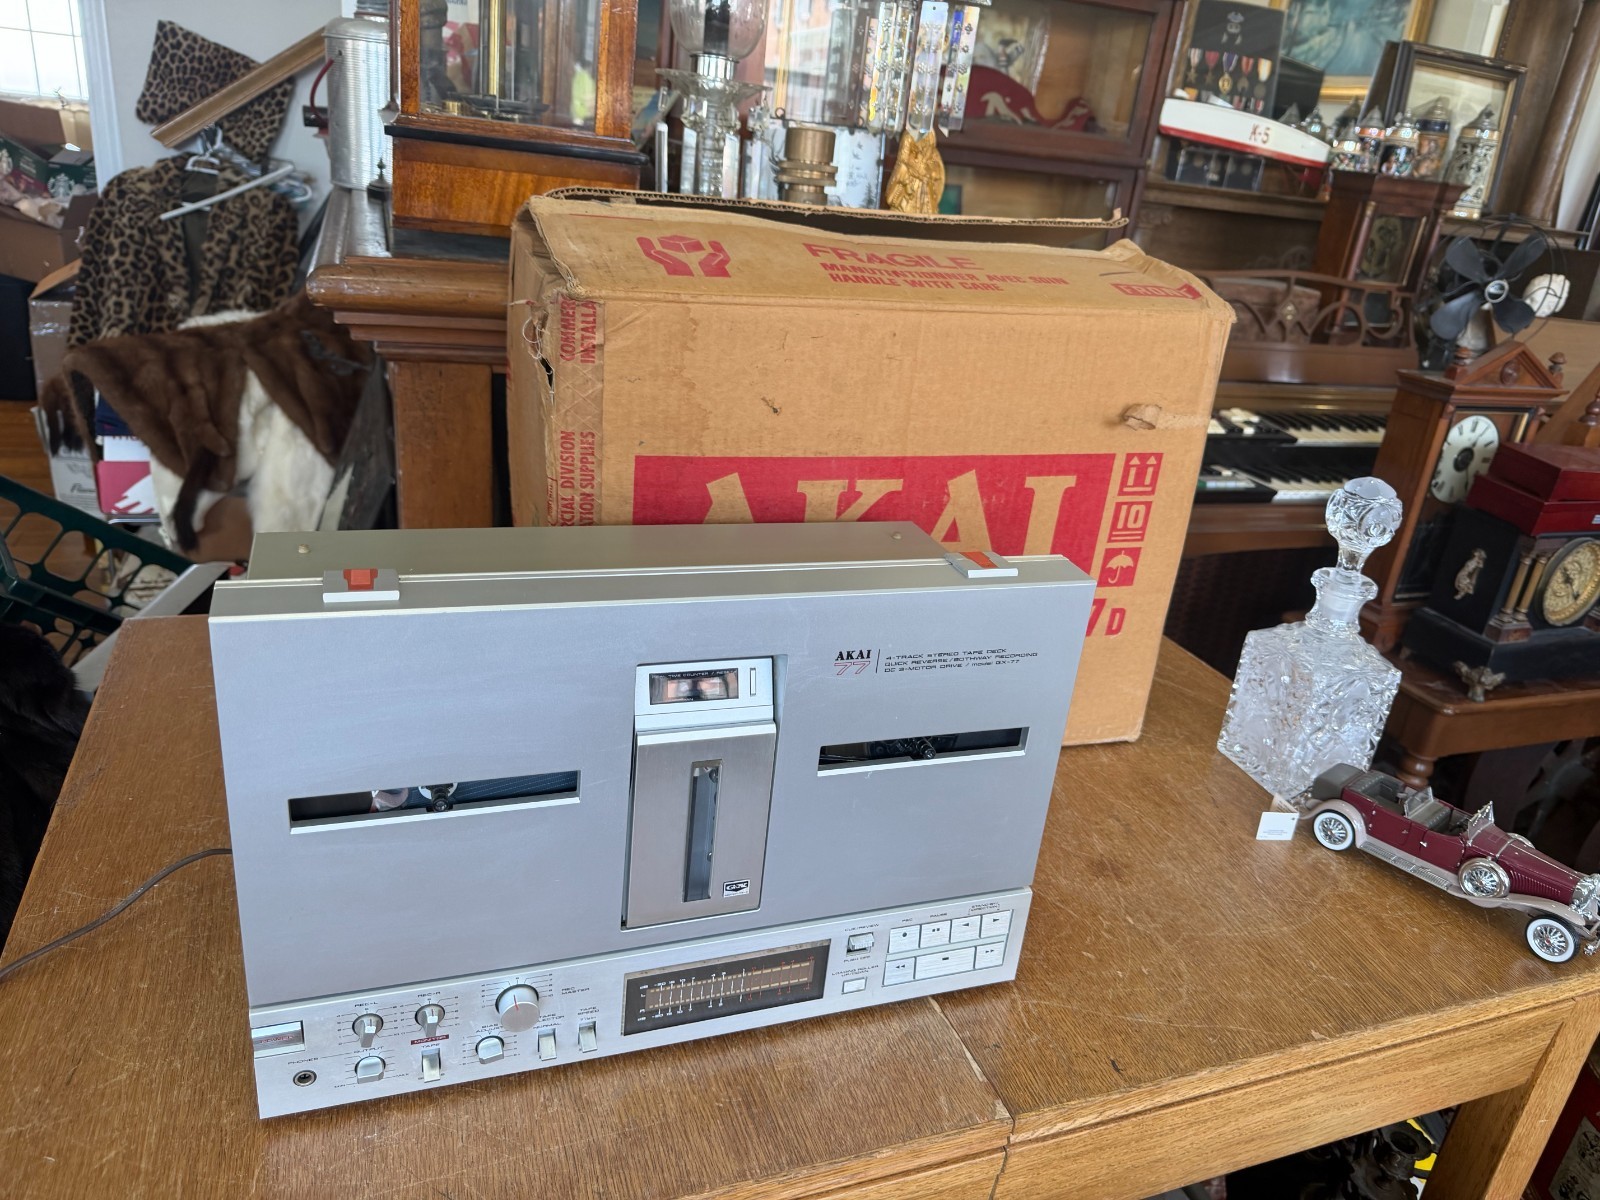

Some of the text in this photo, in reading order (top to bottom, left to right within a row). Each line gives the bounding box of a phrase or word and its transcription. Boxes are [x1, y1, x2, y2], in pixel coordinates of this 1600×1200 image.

[802, 243, 985, 271] FRAGILE
[828, 273, 1004, 292] HANDLE WITH CARE
[986, 274, 1026, 284] AVEC
[1028, 275, 1070, 285] SOIN
[560, 430, 576, 489] DIVISION
[580, 431, 596, 489] SUPPLIES
[1116, 504, 1146, 529] 10
[835, 649, 872, 661] AKAI
[834, 660, 871, 676] 77
[287, 1057, 319, 1065] PHONES
